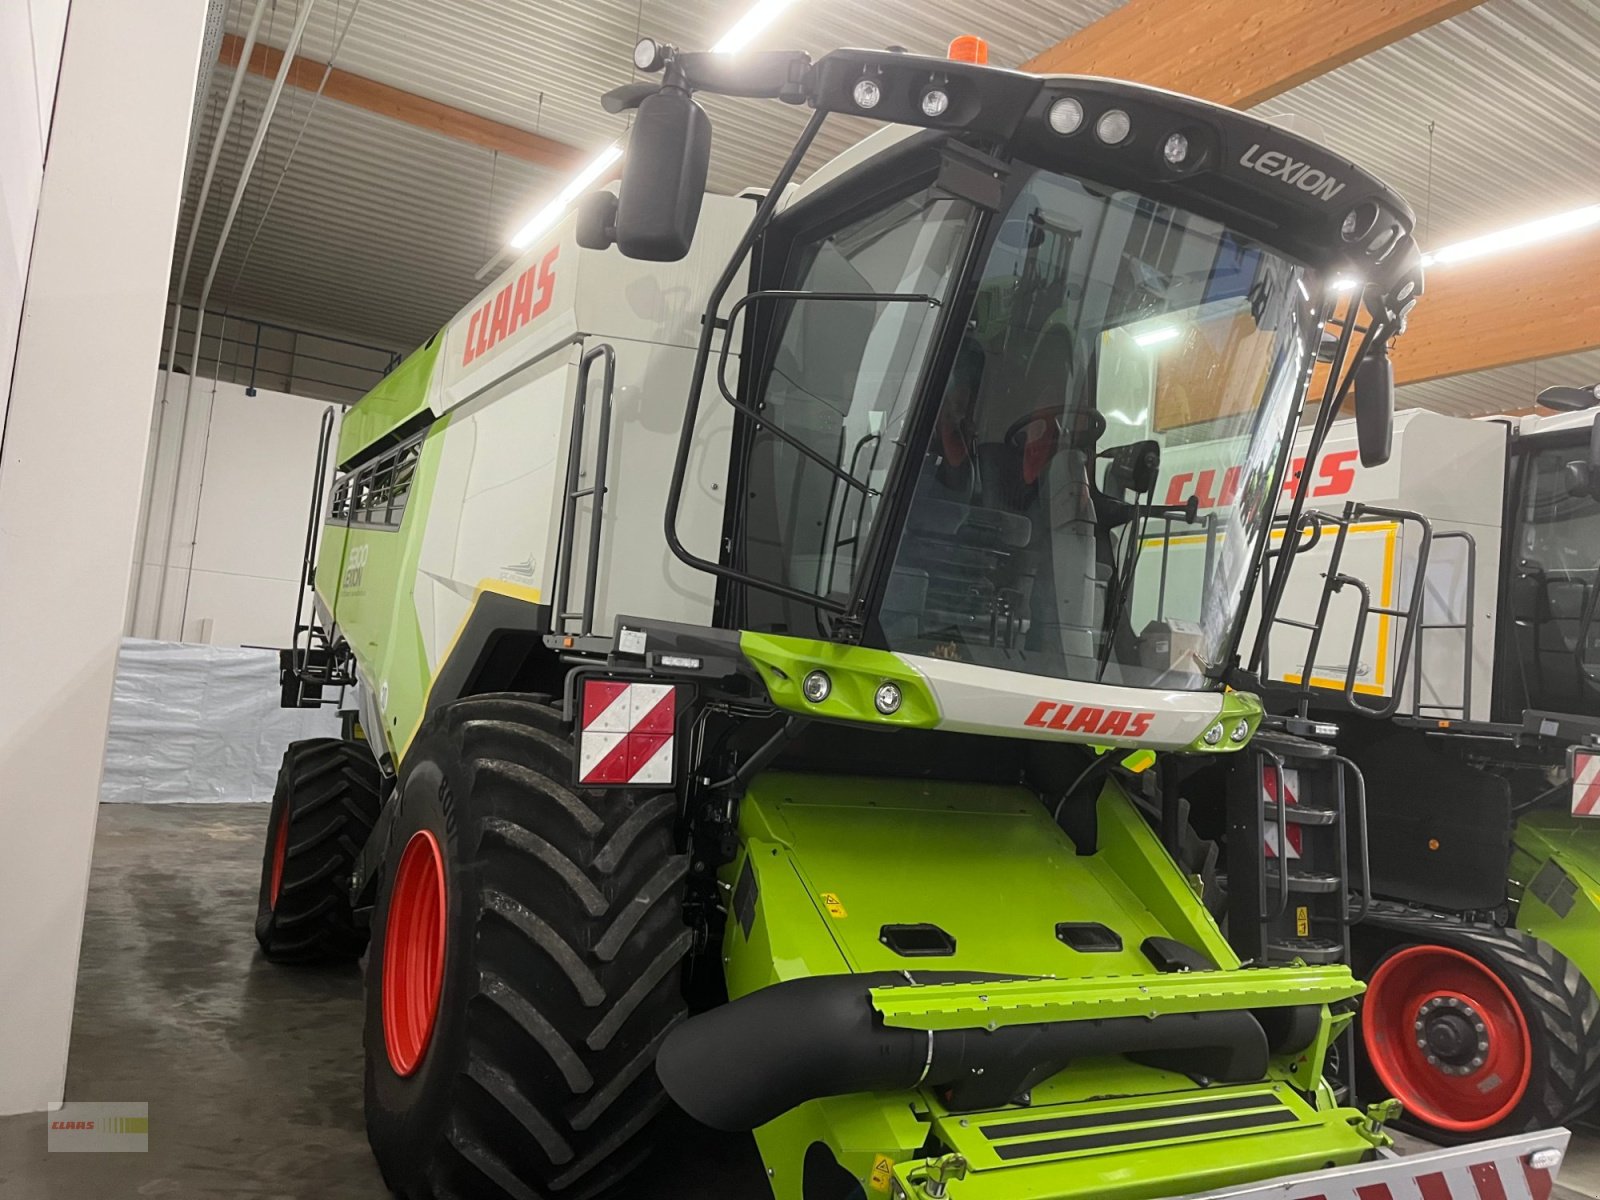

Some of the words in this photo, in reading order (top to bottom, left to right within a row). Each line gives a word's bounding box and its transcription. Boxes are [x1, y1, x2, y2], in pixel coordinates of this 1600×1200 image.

[1239, 143, 1346, 201] LEXION
[463, 245, 561, 366] CLAAS
[1023, 700, 1155, 737] CLAAS
